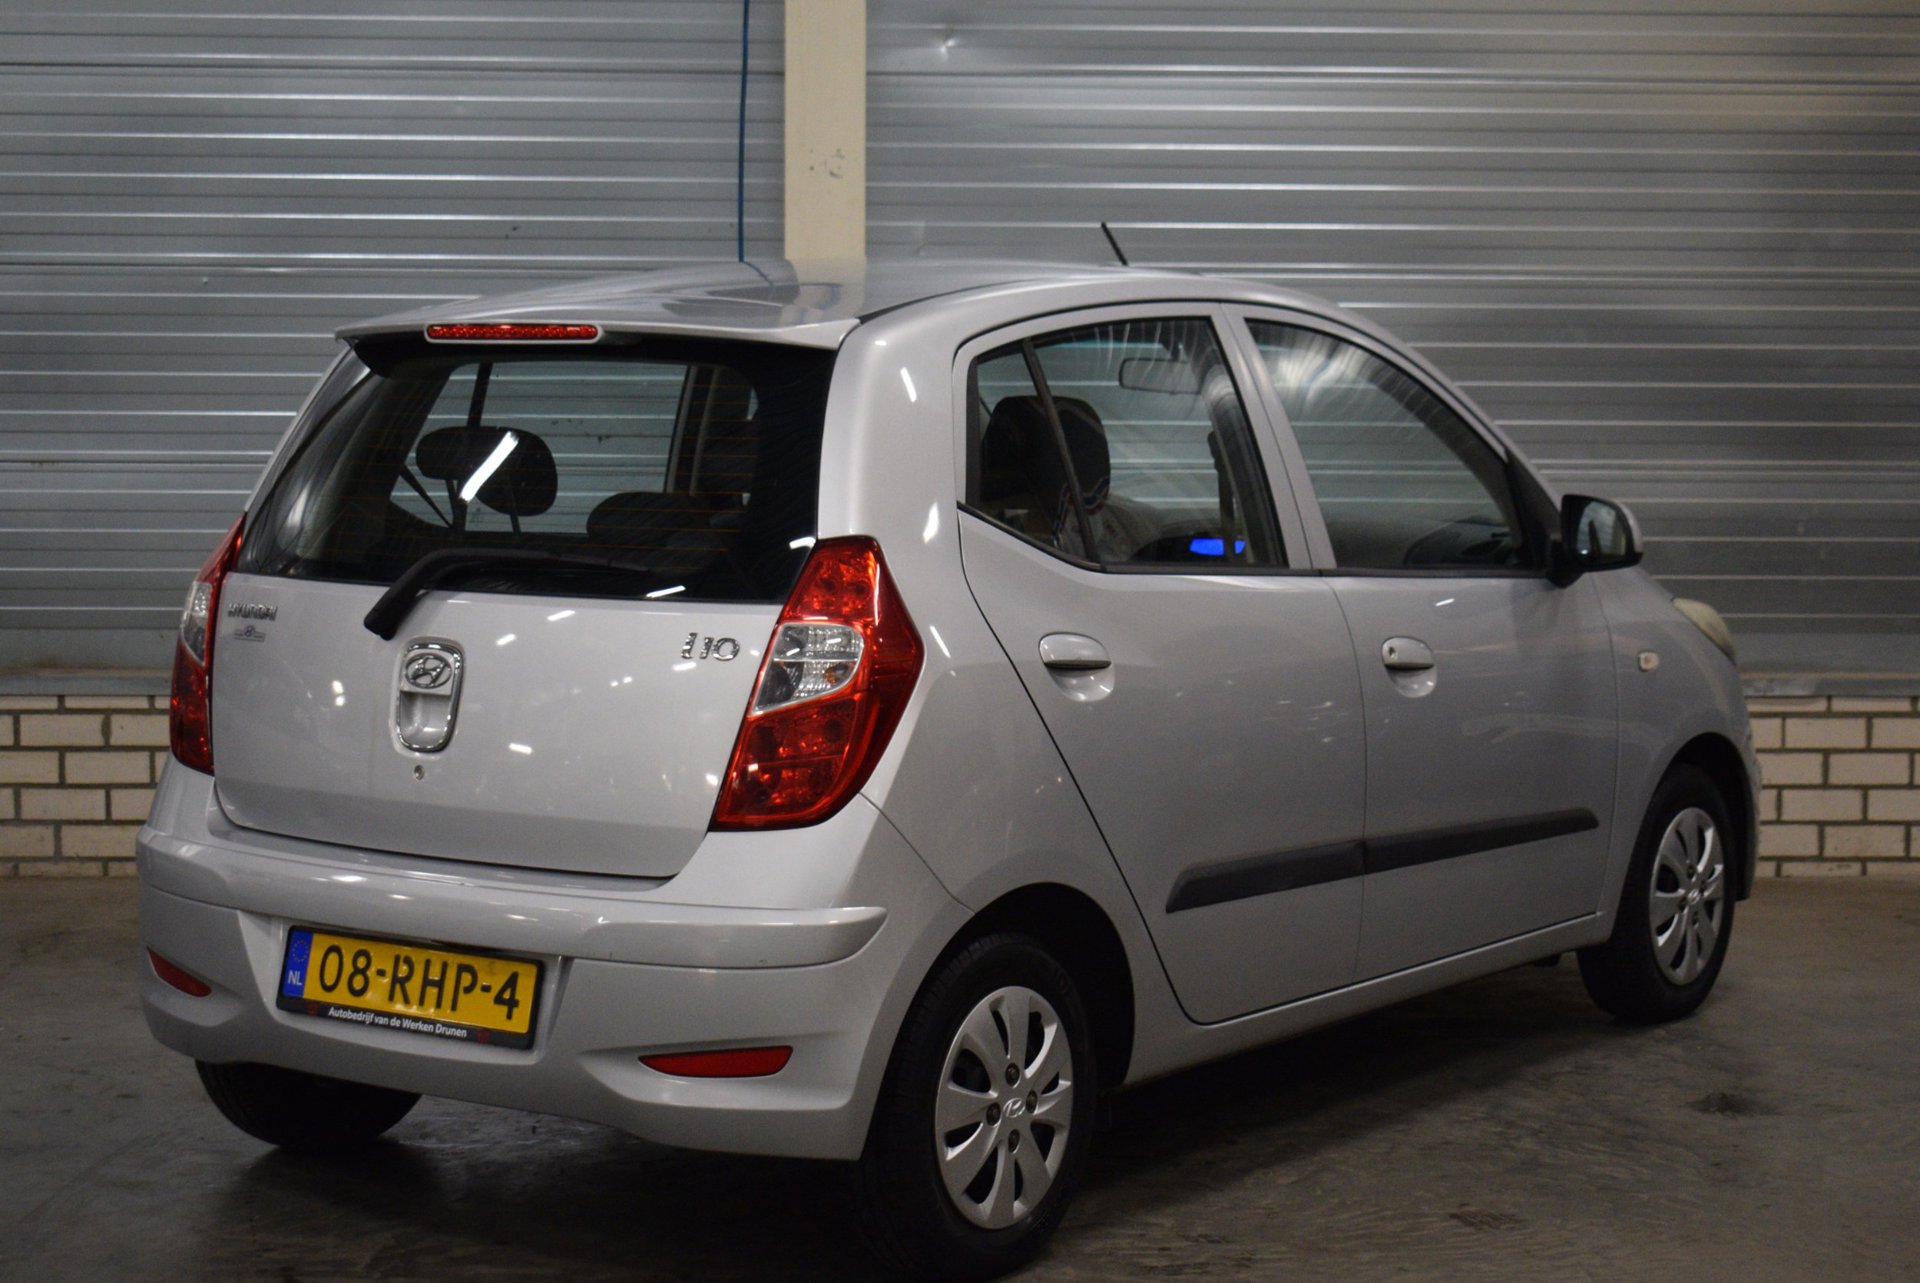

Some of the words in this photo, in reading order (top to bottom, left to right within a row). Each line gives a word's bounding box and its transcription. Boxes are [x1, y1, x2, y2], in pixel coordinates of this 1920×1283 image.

[287, 969, 303, 986] NL
[320, 945, 520, 1020] 08-RHP-4
[329, 1007, 374, 1025] Autobedrijf
[374, 1015, 389, 1026] van
[390, 1016, 401, 1027] de
[401, 1018, 434, 1033] Werken
[435, 1023, 467, 1038] Drunen
